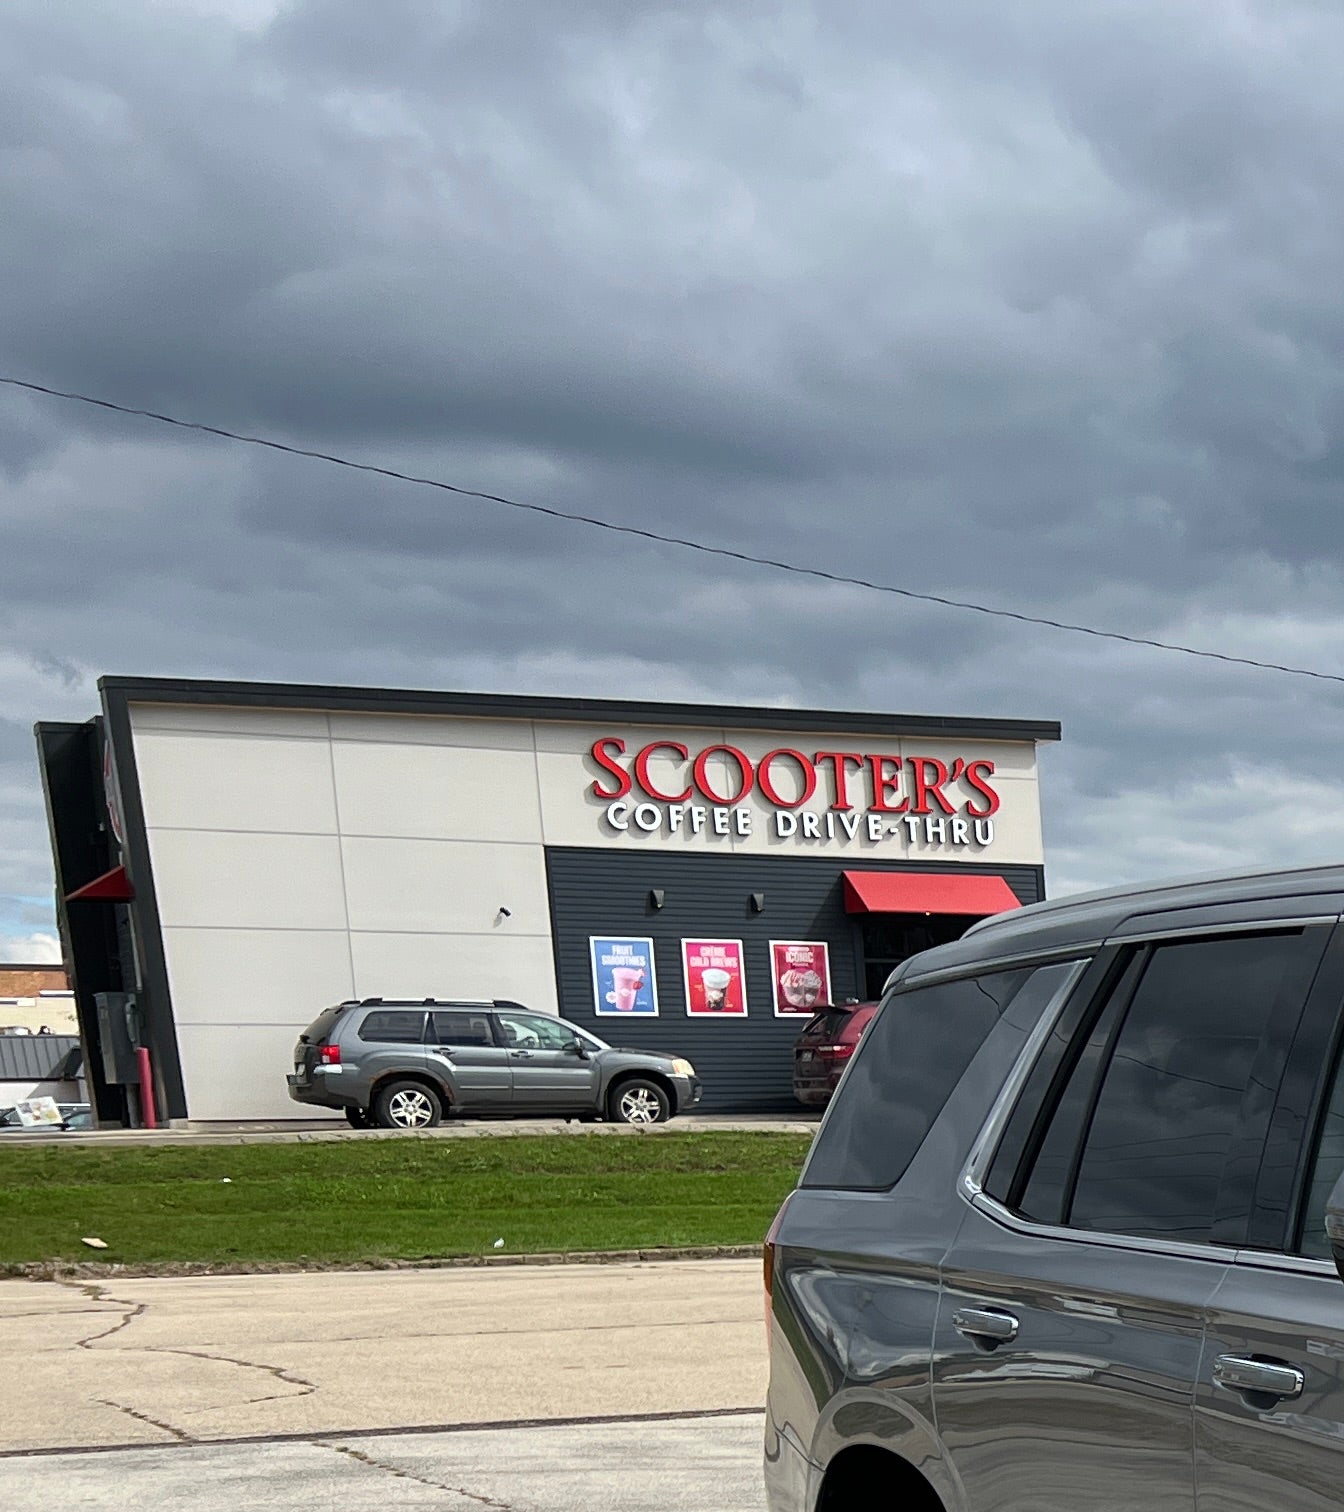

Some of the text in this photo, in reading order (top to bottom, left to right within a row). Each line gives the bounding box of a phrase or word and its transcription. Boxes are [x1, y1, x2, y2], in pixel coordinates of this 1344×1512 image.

[591, 737, 1000, 817] SCOOTER'S
[607, 801, 996, 846] COFFEE DRIVE-THRU
